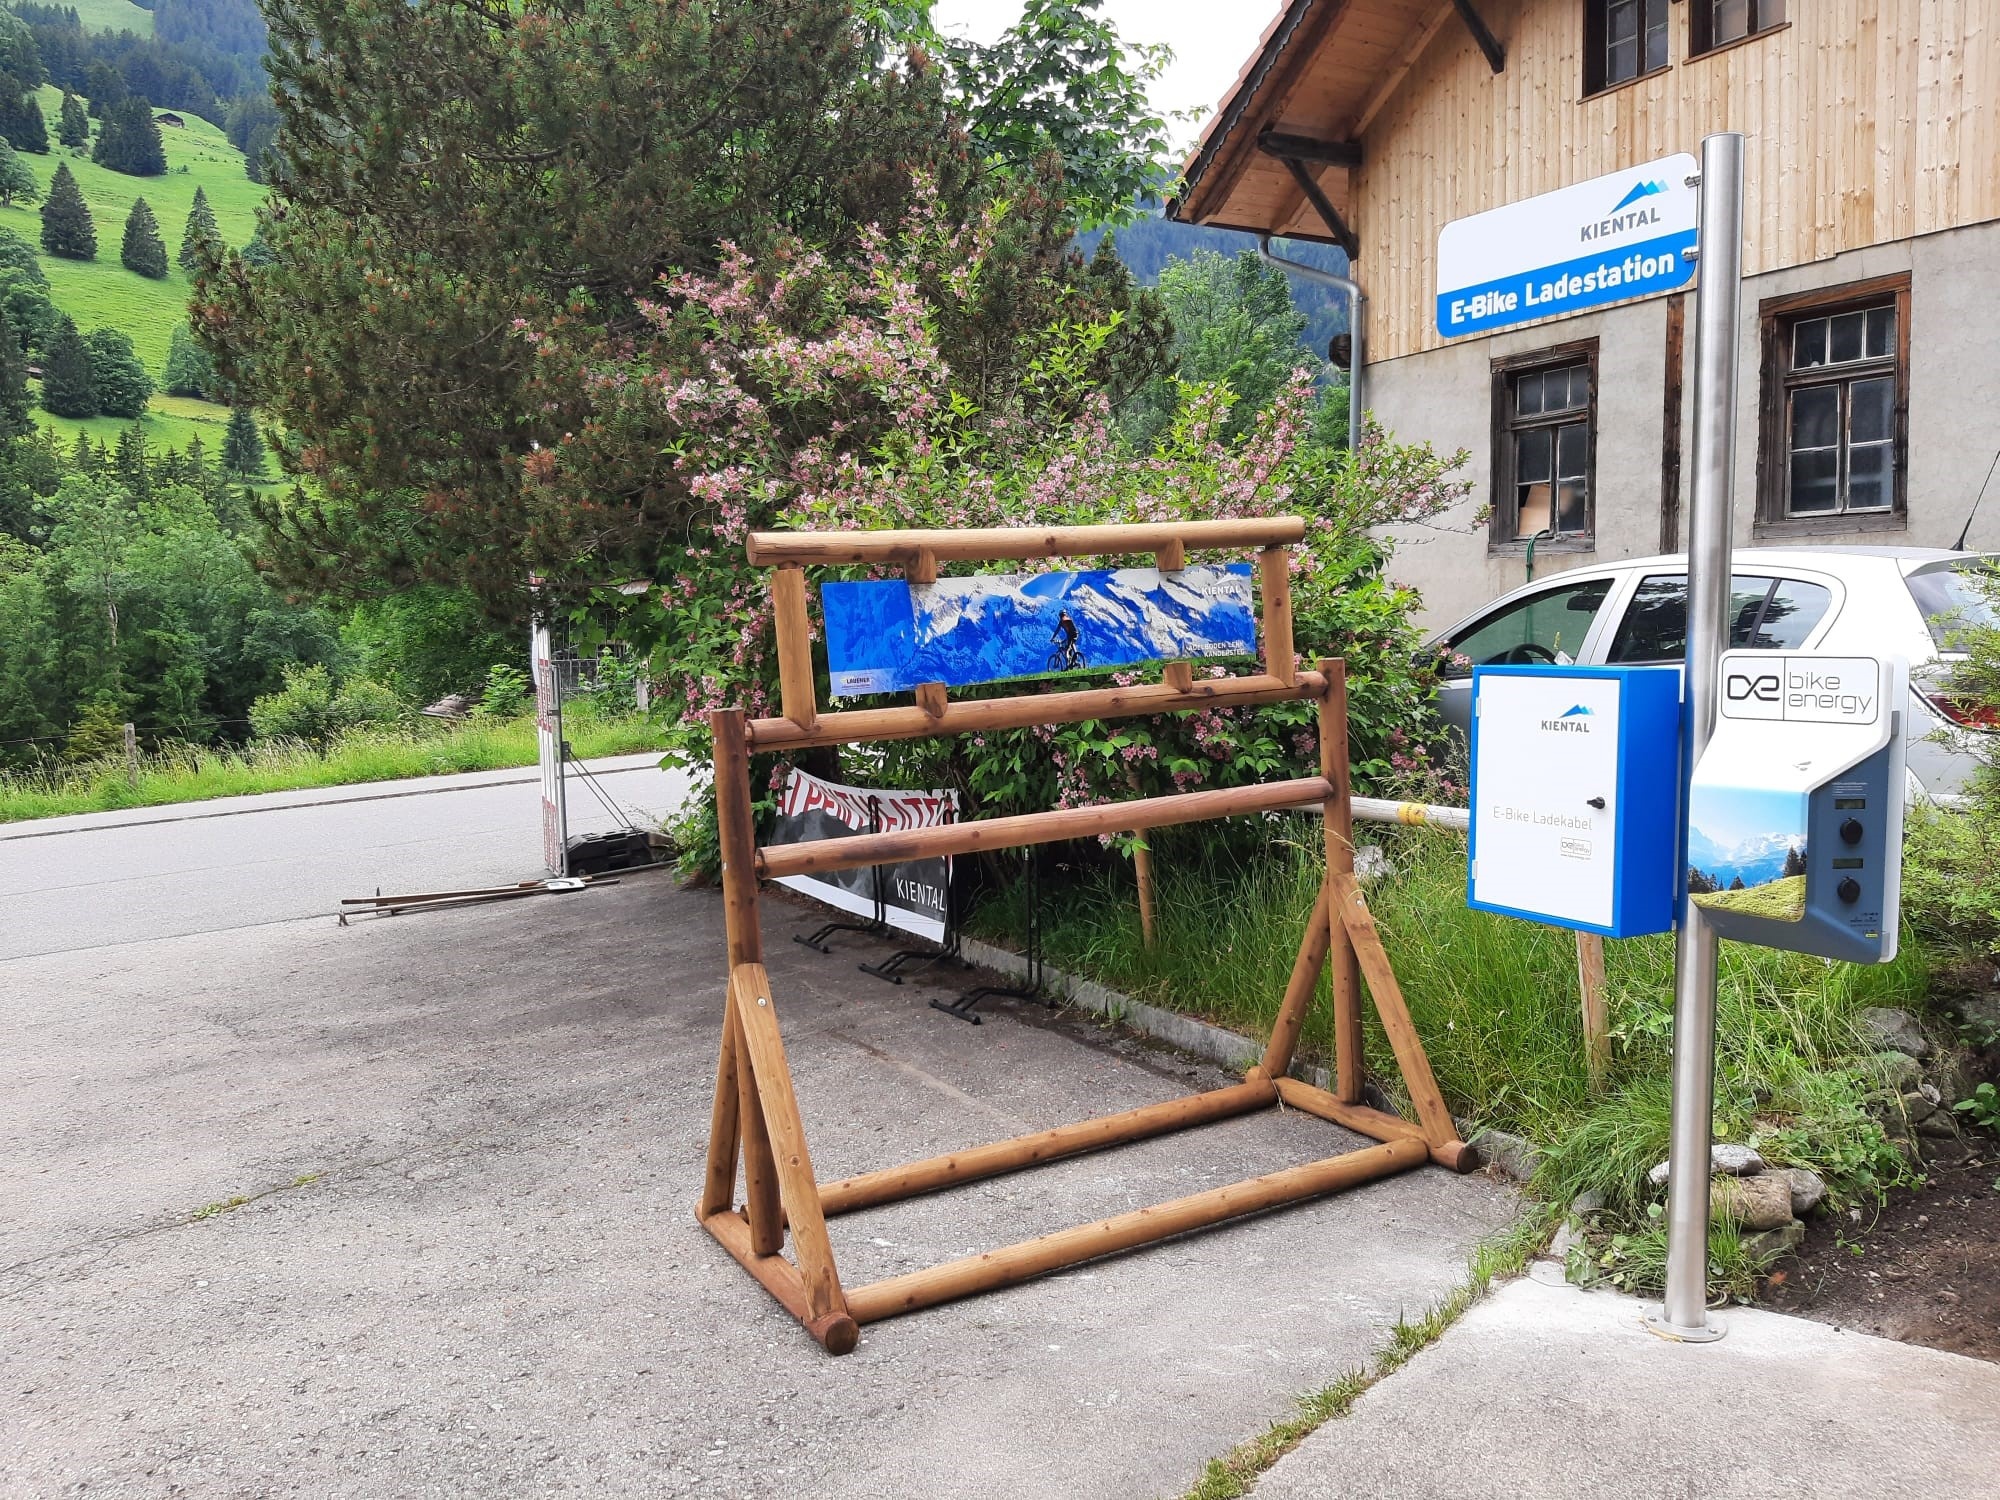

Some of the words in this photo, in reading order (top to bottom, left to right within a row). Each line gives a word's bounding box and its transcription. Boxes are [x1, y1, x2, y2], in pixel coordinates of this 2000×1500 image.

[1580, 207, 1661, 242] KIENTAL
[1450, 290, 1518, 325] E-Bike
[1525, 252, 1675, 307] Ladestation
[1202, 585, 1241, 596] KIENTAL
[1788, 671, 1841, 690] bike
[1788, 691, 1872, 715] energy
[1540, 719, 1590, 733] KIENTAL
[1493, 806, 1530, 822] E-Bike
[1533, 810, 1593, 831] Ladekabel
[896, 877, 945, 912] KIENTAL
